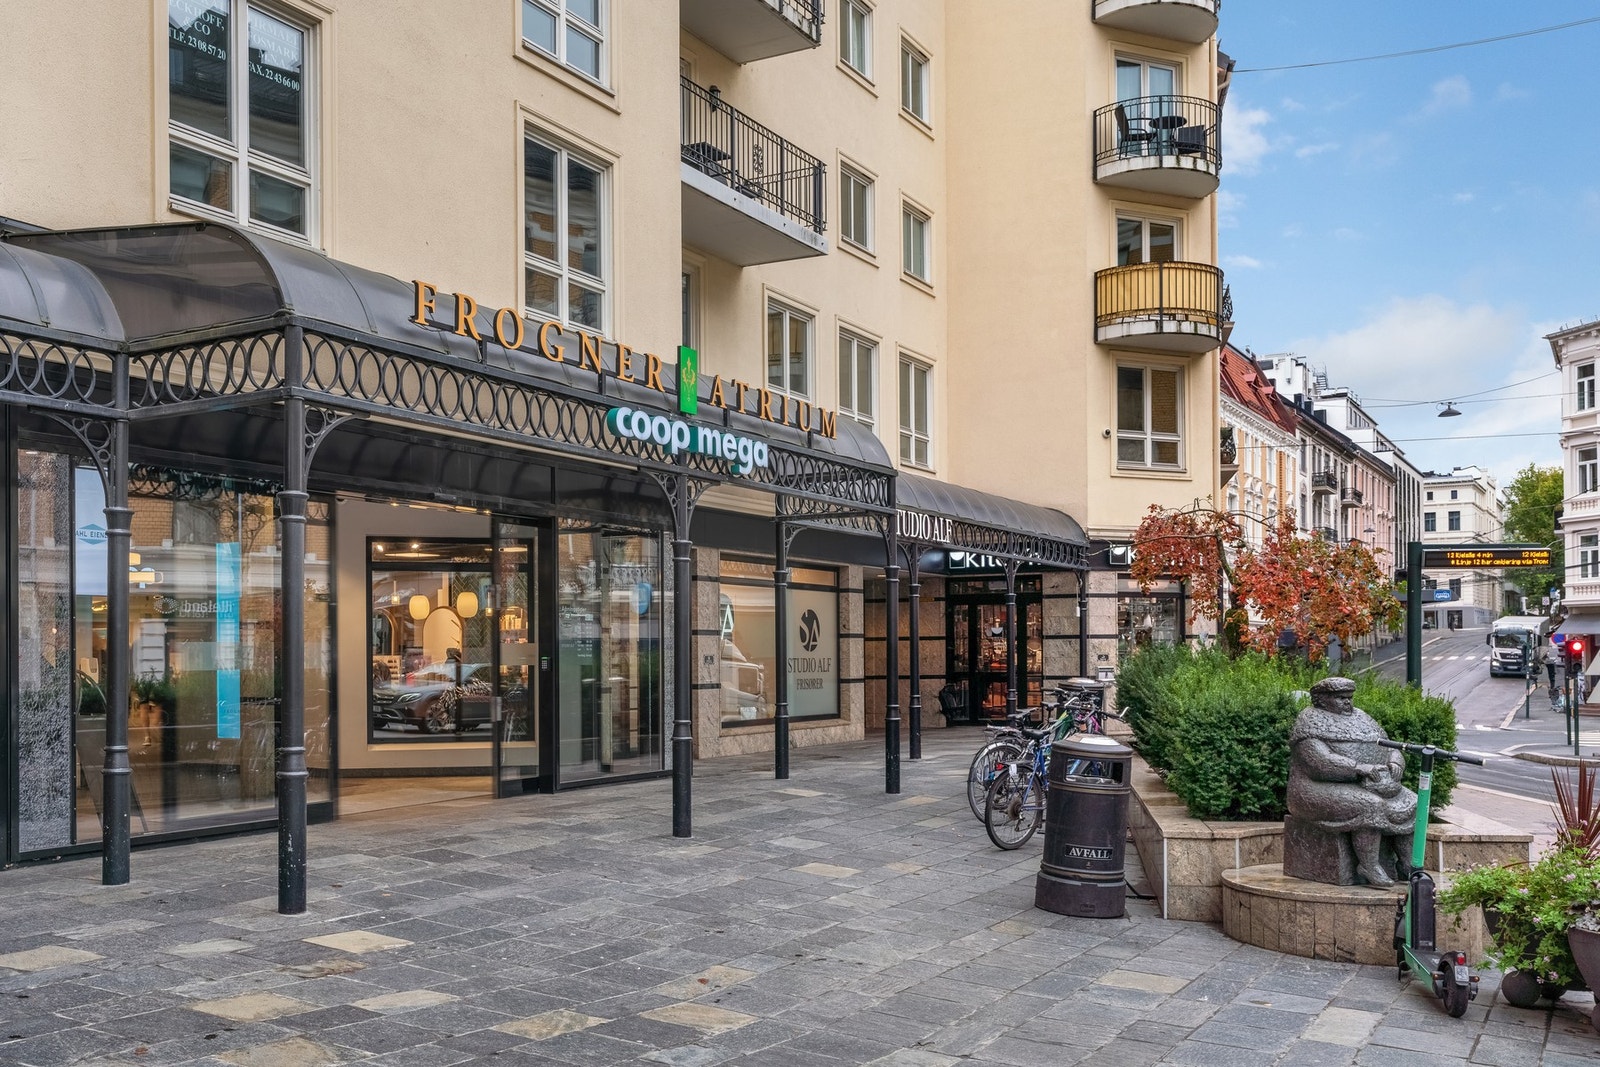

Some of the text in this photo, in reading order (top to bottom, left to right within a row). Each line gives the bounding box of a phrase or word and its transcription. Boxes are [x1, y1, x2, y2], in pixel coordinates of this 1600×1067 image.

[194, 21, 211, 35] CO
[412, 279, 838, 440] FROGNER ATRIUM
[611, 406, 769, 475] coop mega
[896, 509, 953, 543] TUDIO ALF
[787, 657, 832, 674] STUDIO ALF
[1069, 847, 1110, 860] AVFALL
